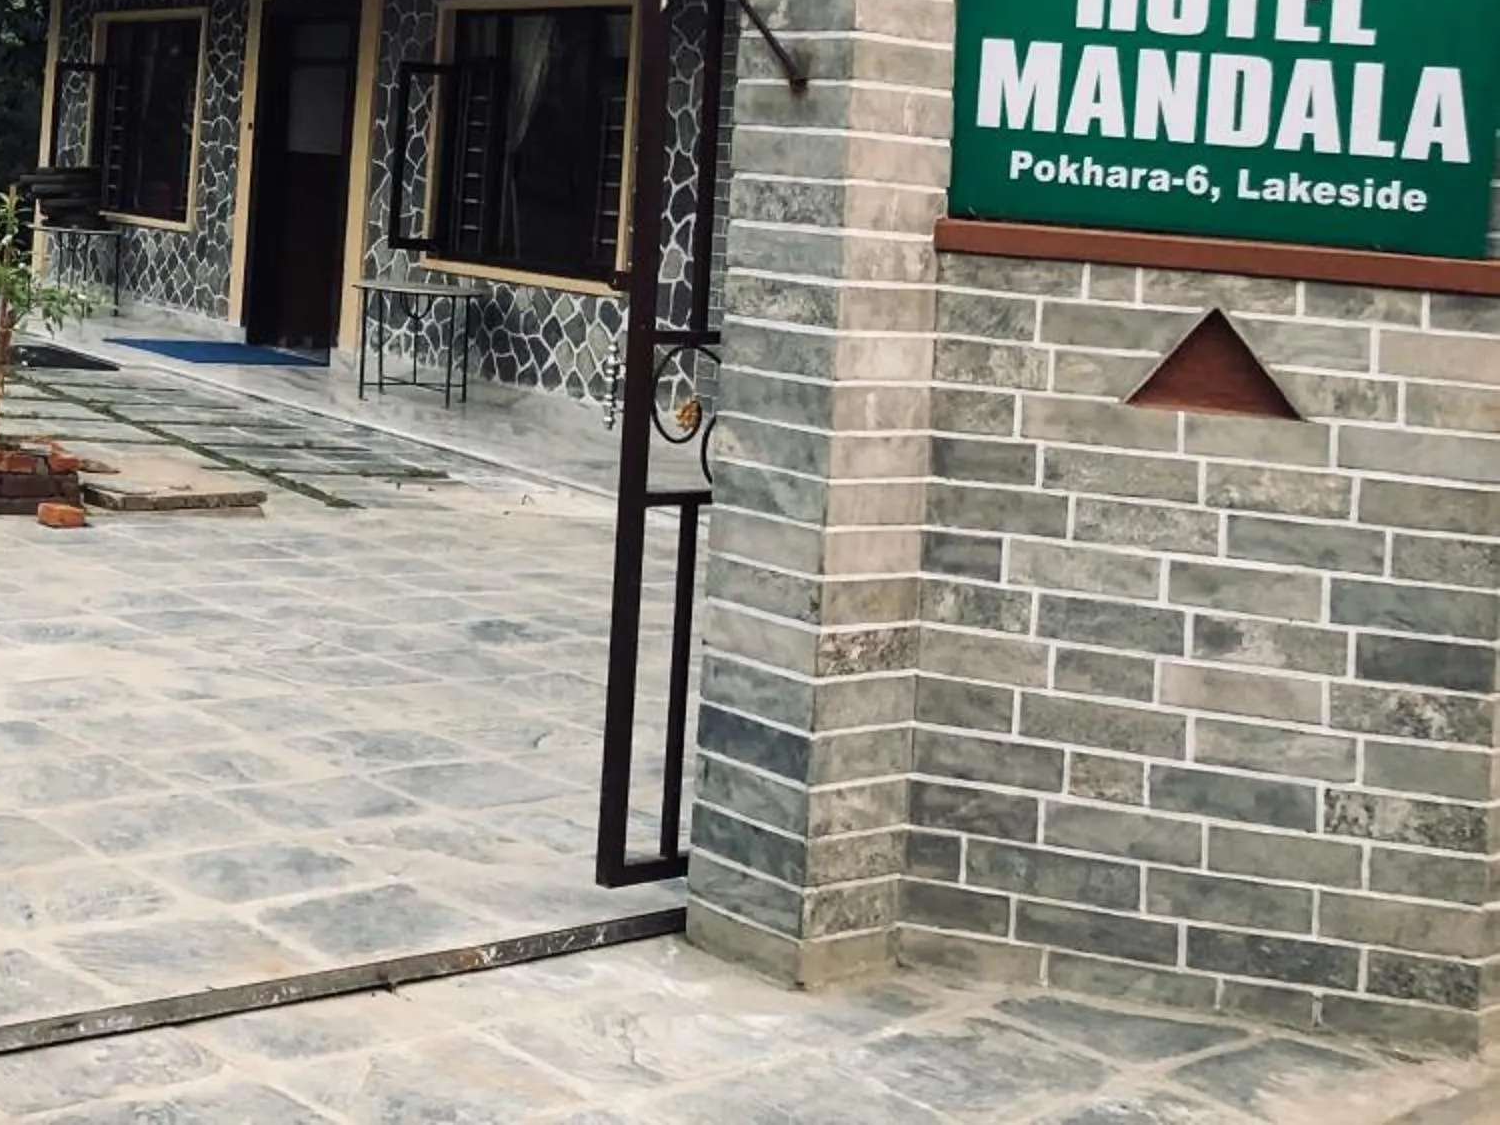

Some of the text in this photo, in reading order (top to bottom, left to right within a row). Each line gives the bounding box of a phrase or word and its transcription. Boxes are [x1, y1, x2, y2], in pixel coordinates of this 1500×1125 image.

[977, 38, 1470, 163] MANDALA
[1010, 150, 1428, 212] Pokhara-6, Lakeside
